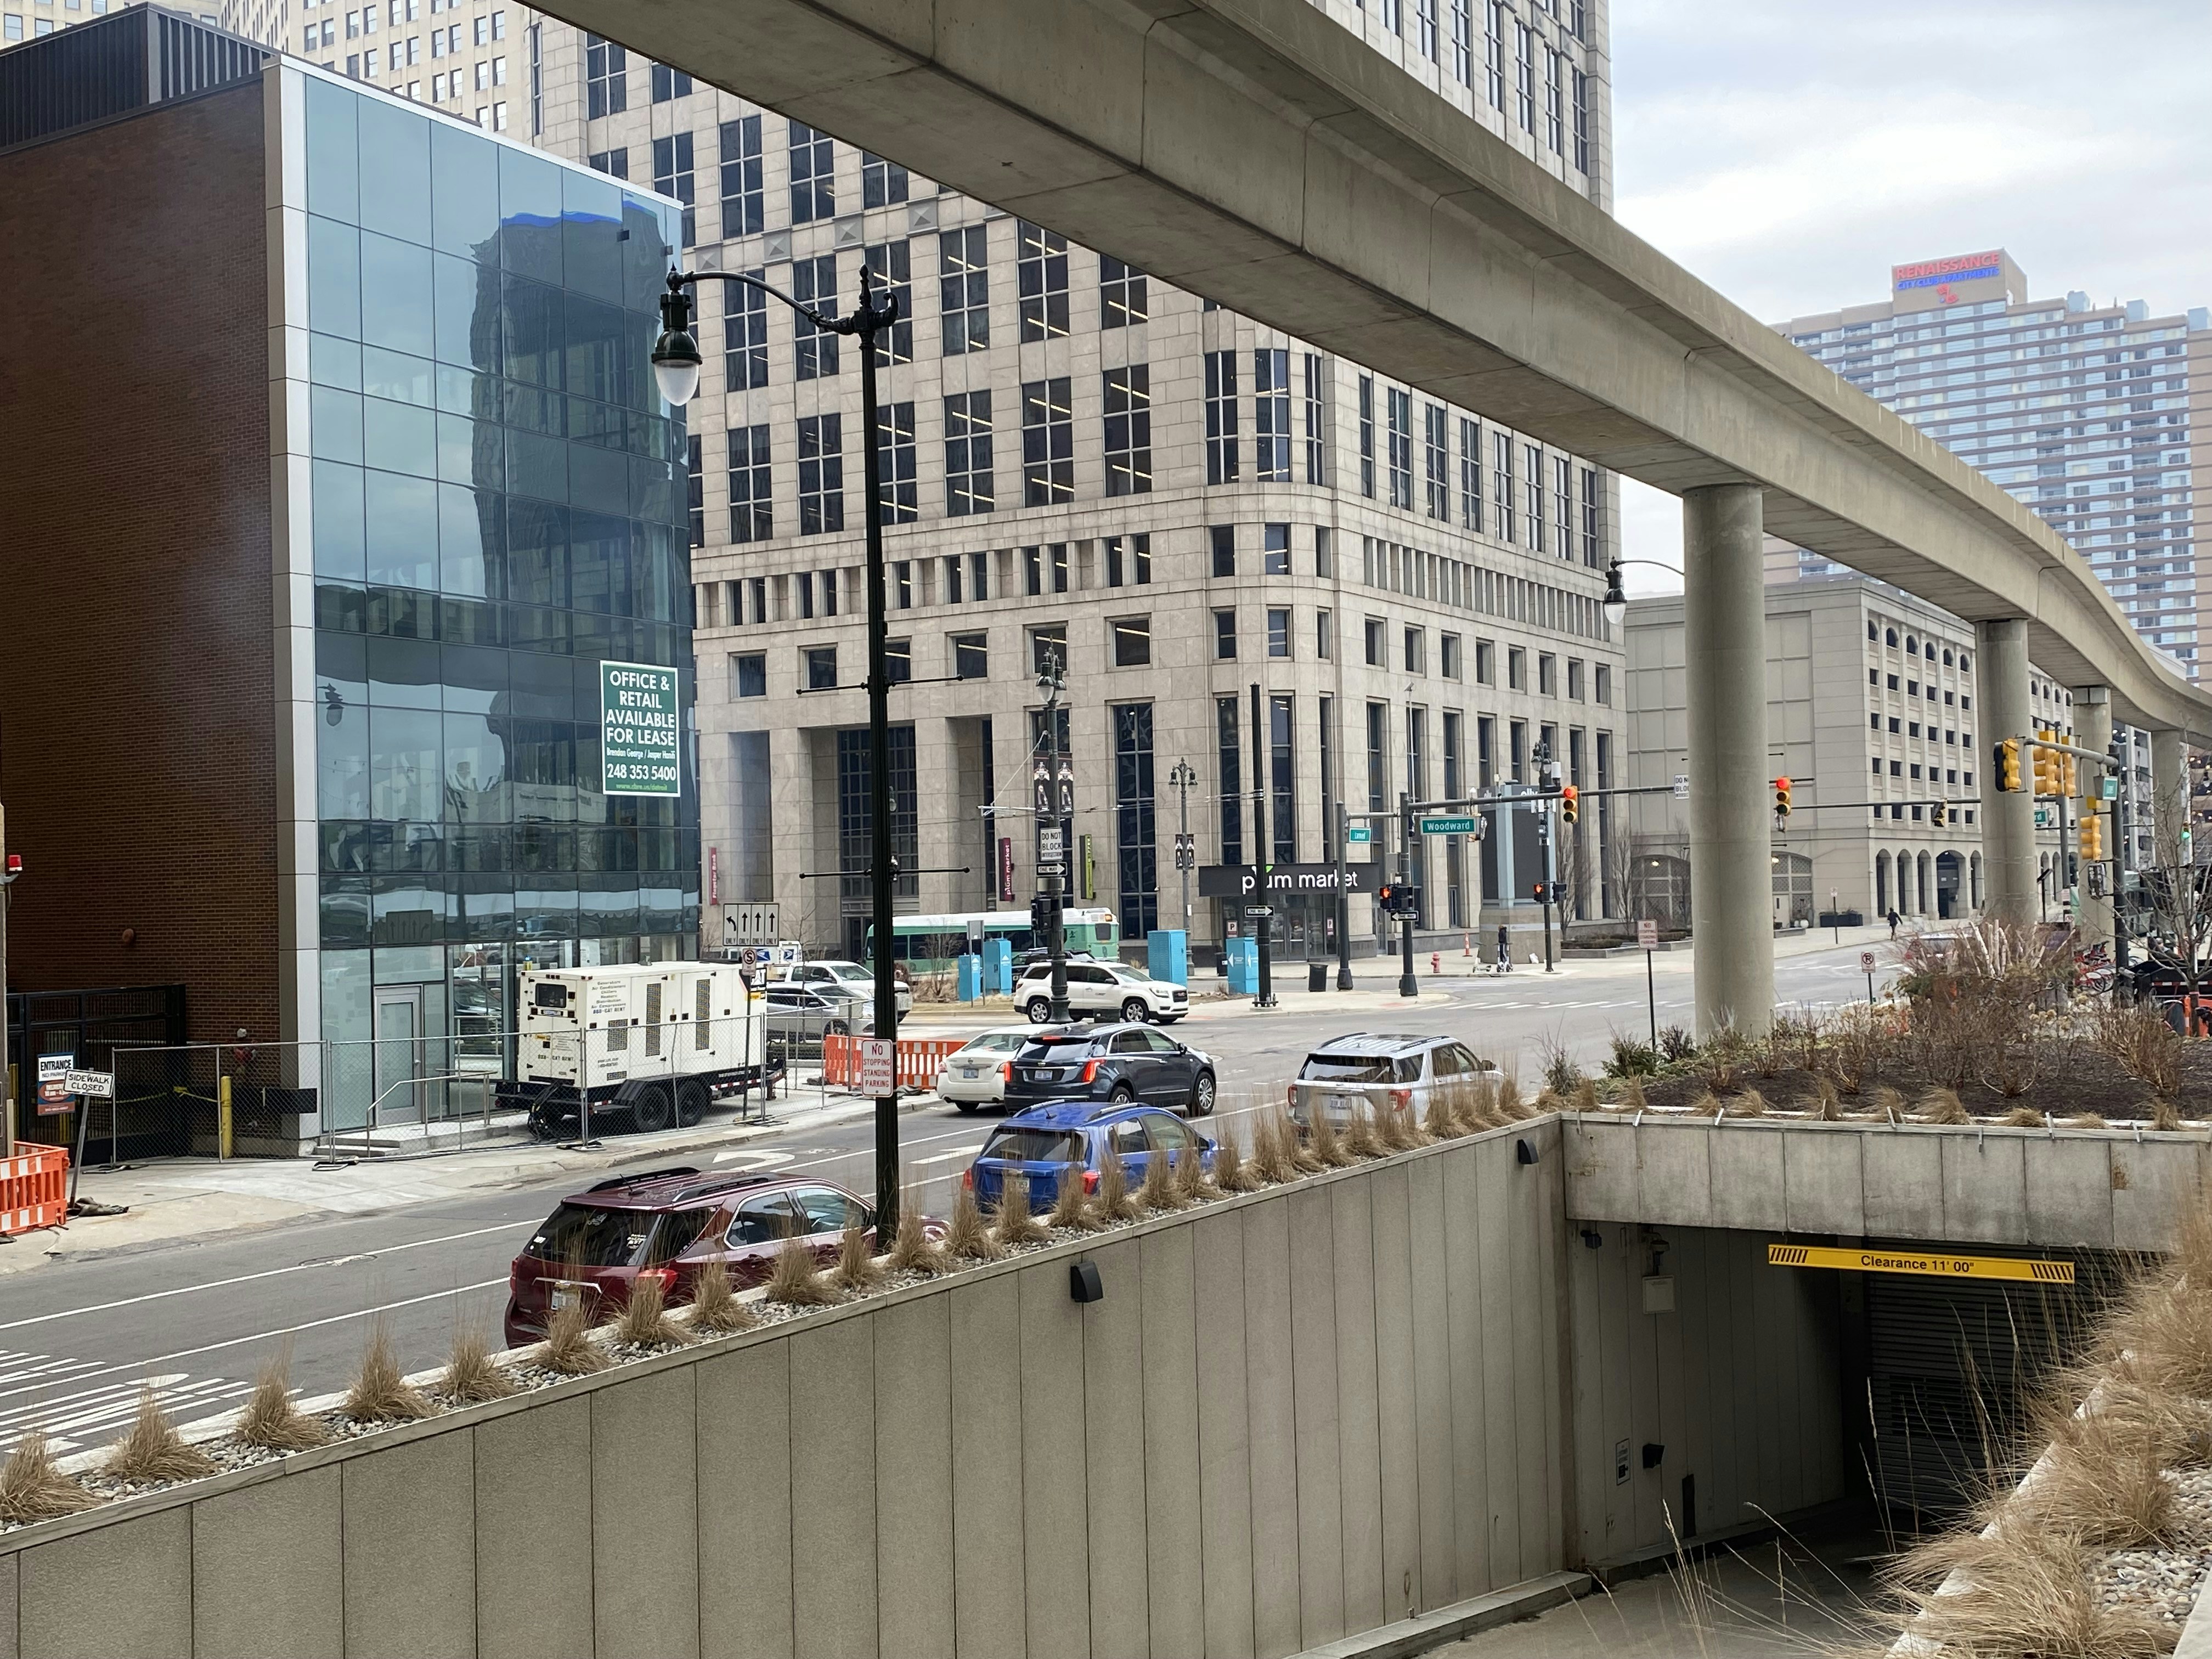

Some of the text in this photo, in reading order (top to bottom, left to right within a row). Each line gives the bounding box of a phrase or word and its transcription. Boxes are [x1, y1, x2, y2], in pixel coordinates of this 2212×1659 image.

[1897, 252, 2000, 279] RENAISSANCE
[1897, 266, 2000, 290] CITY CLUB APARTMENTS
[610, 670, 670, 691] OFFICE &
[619, 690, 662, 709] RETAIL
[606, 709, 675, 728] AVAILABLE
[606, 727, 674, 746] FOR LEASE
[627, 748, 643, 760] George
[607, 763, 676, 781] 248 353 5400
[1427, 822, 1470, 831] Woodward
[872, 1045, 883, 1055] NO
[41, 1059, 71, 1071] ENTRANCE
[69, 1074, 109, 1084] SIDEWALK
[71, 1082, 104, 1092] CLOSED
[1861, 1255, 1974, 1272] Clearance 11' 00"
